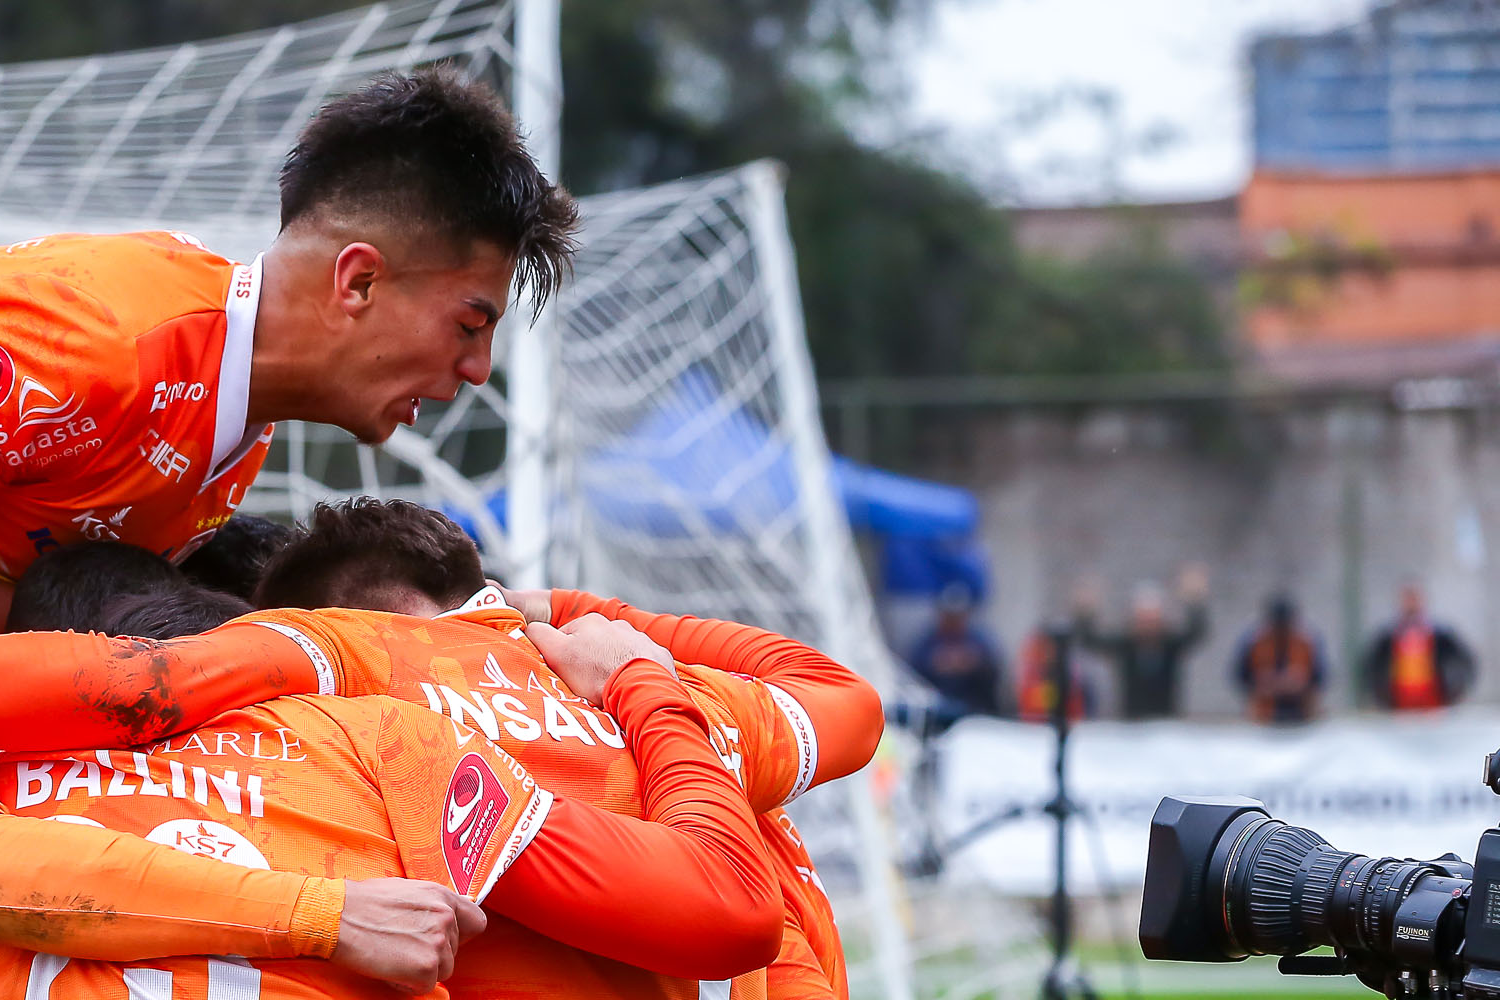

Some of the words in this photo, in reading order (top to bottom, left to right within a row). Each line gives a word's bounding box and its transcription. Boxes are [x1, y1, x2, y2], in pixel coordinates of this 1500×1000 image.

[16, 750, 265, 817] BALLINI
[176, 831, 236, 858] KS7
[1397, 925, 1430, 936] FUJINON
